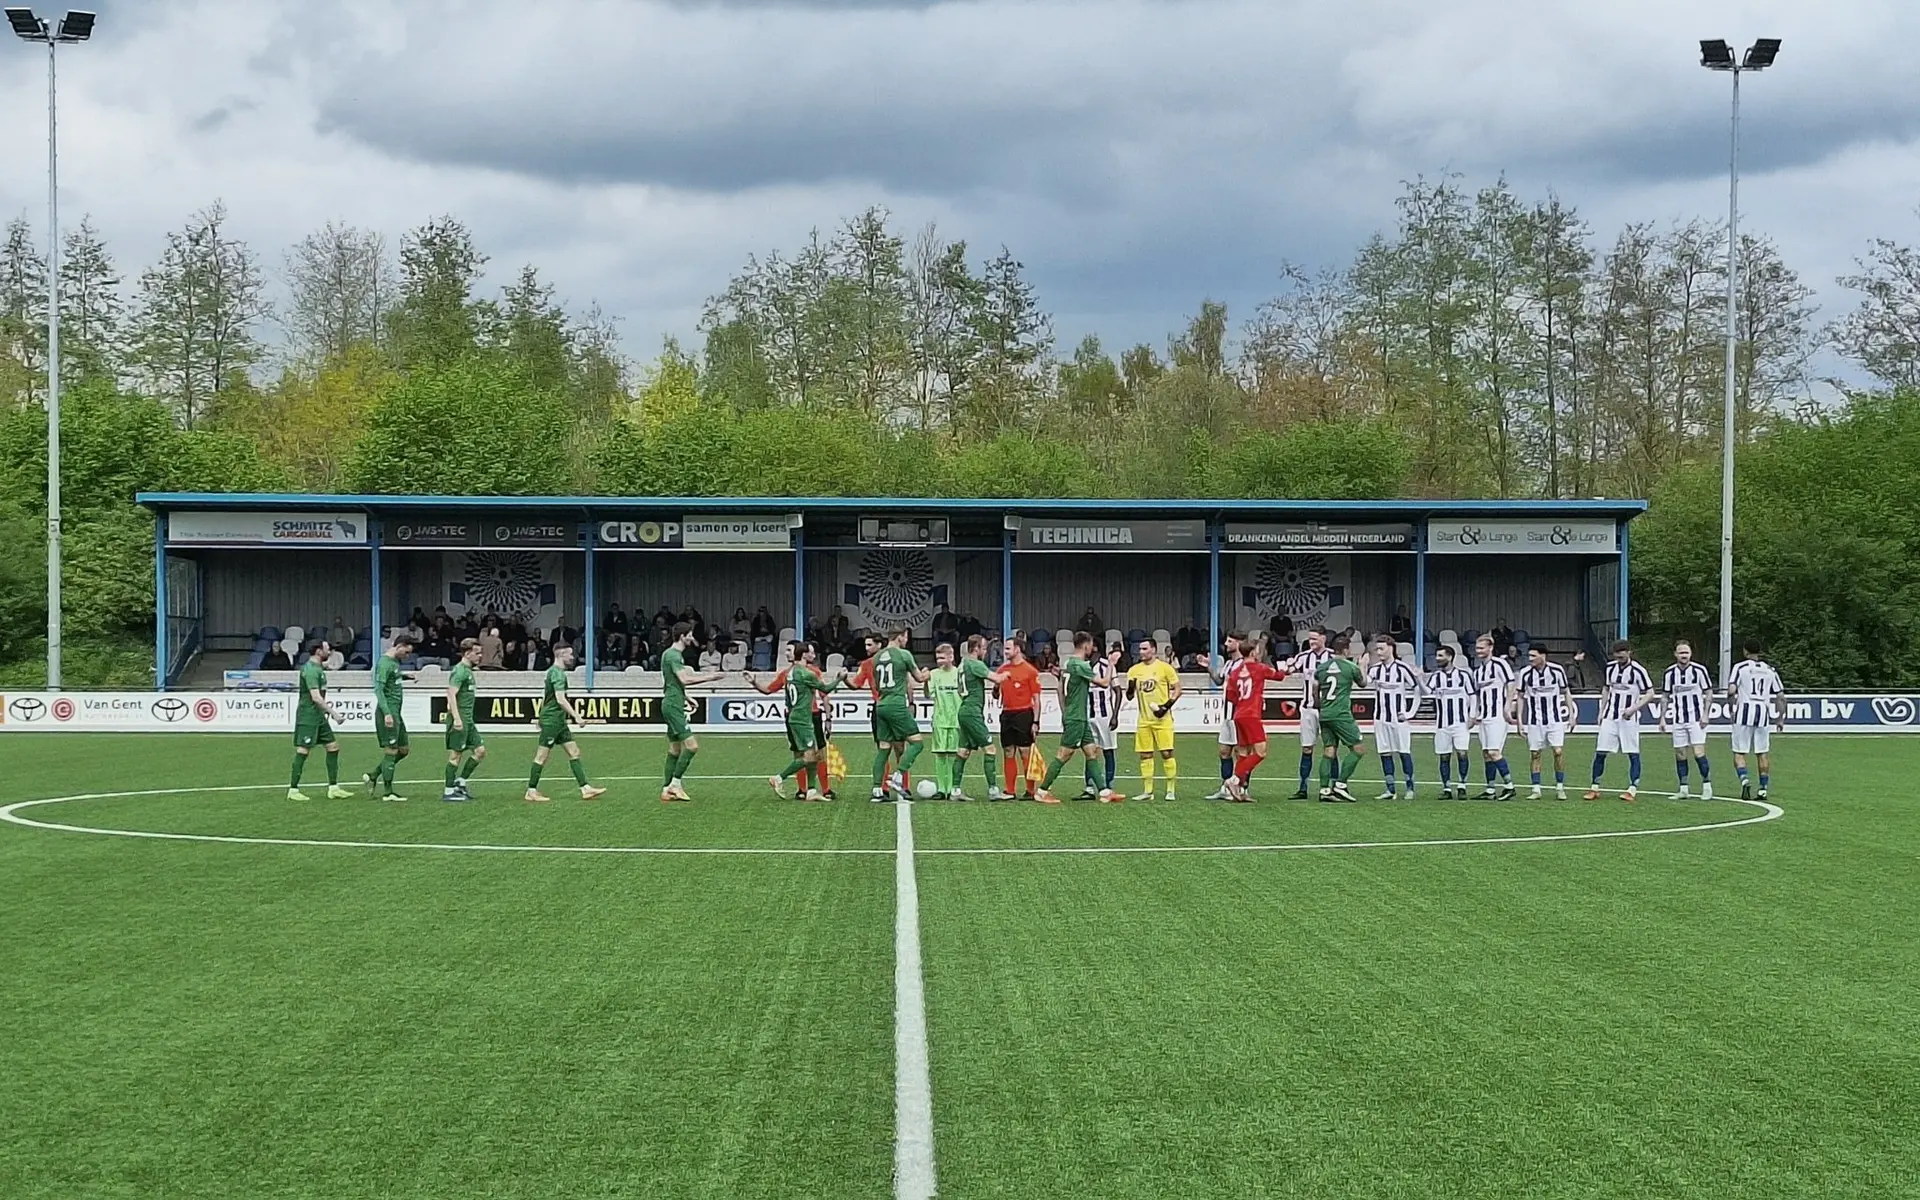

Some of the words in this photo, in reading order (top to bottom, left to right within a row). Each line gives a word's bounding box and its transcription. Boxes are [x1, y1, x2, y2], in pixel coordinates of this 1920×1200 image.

[273, 521, 333, 530] SCHMITZ
[600, 522, 680, 543] CROP
[686, 524, 729, 533] samen
[733, 524, 748, 535] op
[753, 522, 787, 533] koers
[1030, 528, 1133, 544] TECHNICA
[1228, 534, 1311, 543] DRANKENHANDEL
[1312, 534, 1348, 543] MIDDEN
[1350, 534, 1405, 543] NEDERLAND
[876, 662, 896, 688] 21
[1326, 676, 1337, 700] 2
[1751, 677, 1765, 696] 14
[84, 699, 109, 709] Van
[112, 699, 142, 709] Gent
[226, 699, 250, 709] Van
[253, 699, 285, 709] Gent
[490, 698, 525, 718] ALL
[575, 698, 611, 718] CAN
[618, 698, 654, 718] EAT
[1821, 699, 1854, 718] bv
